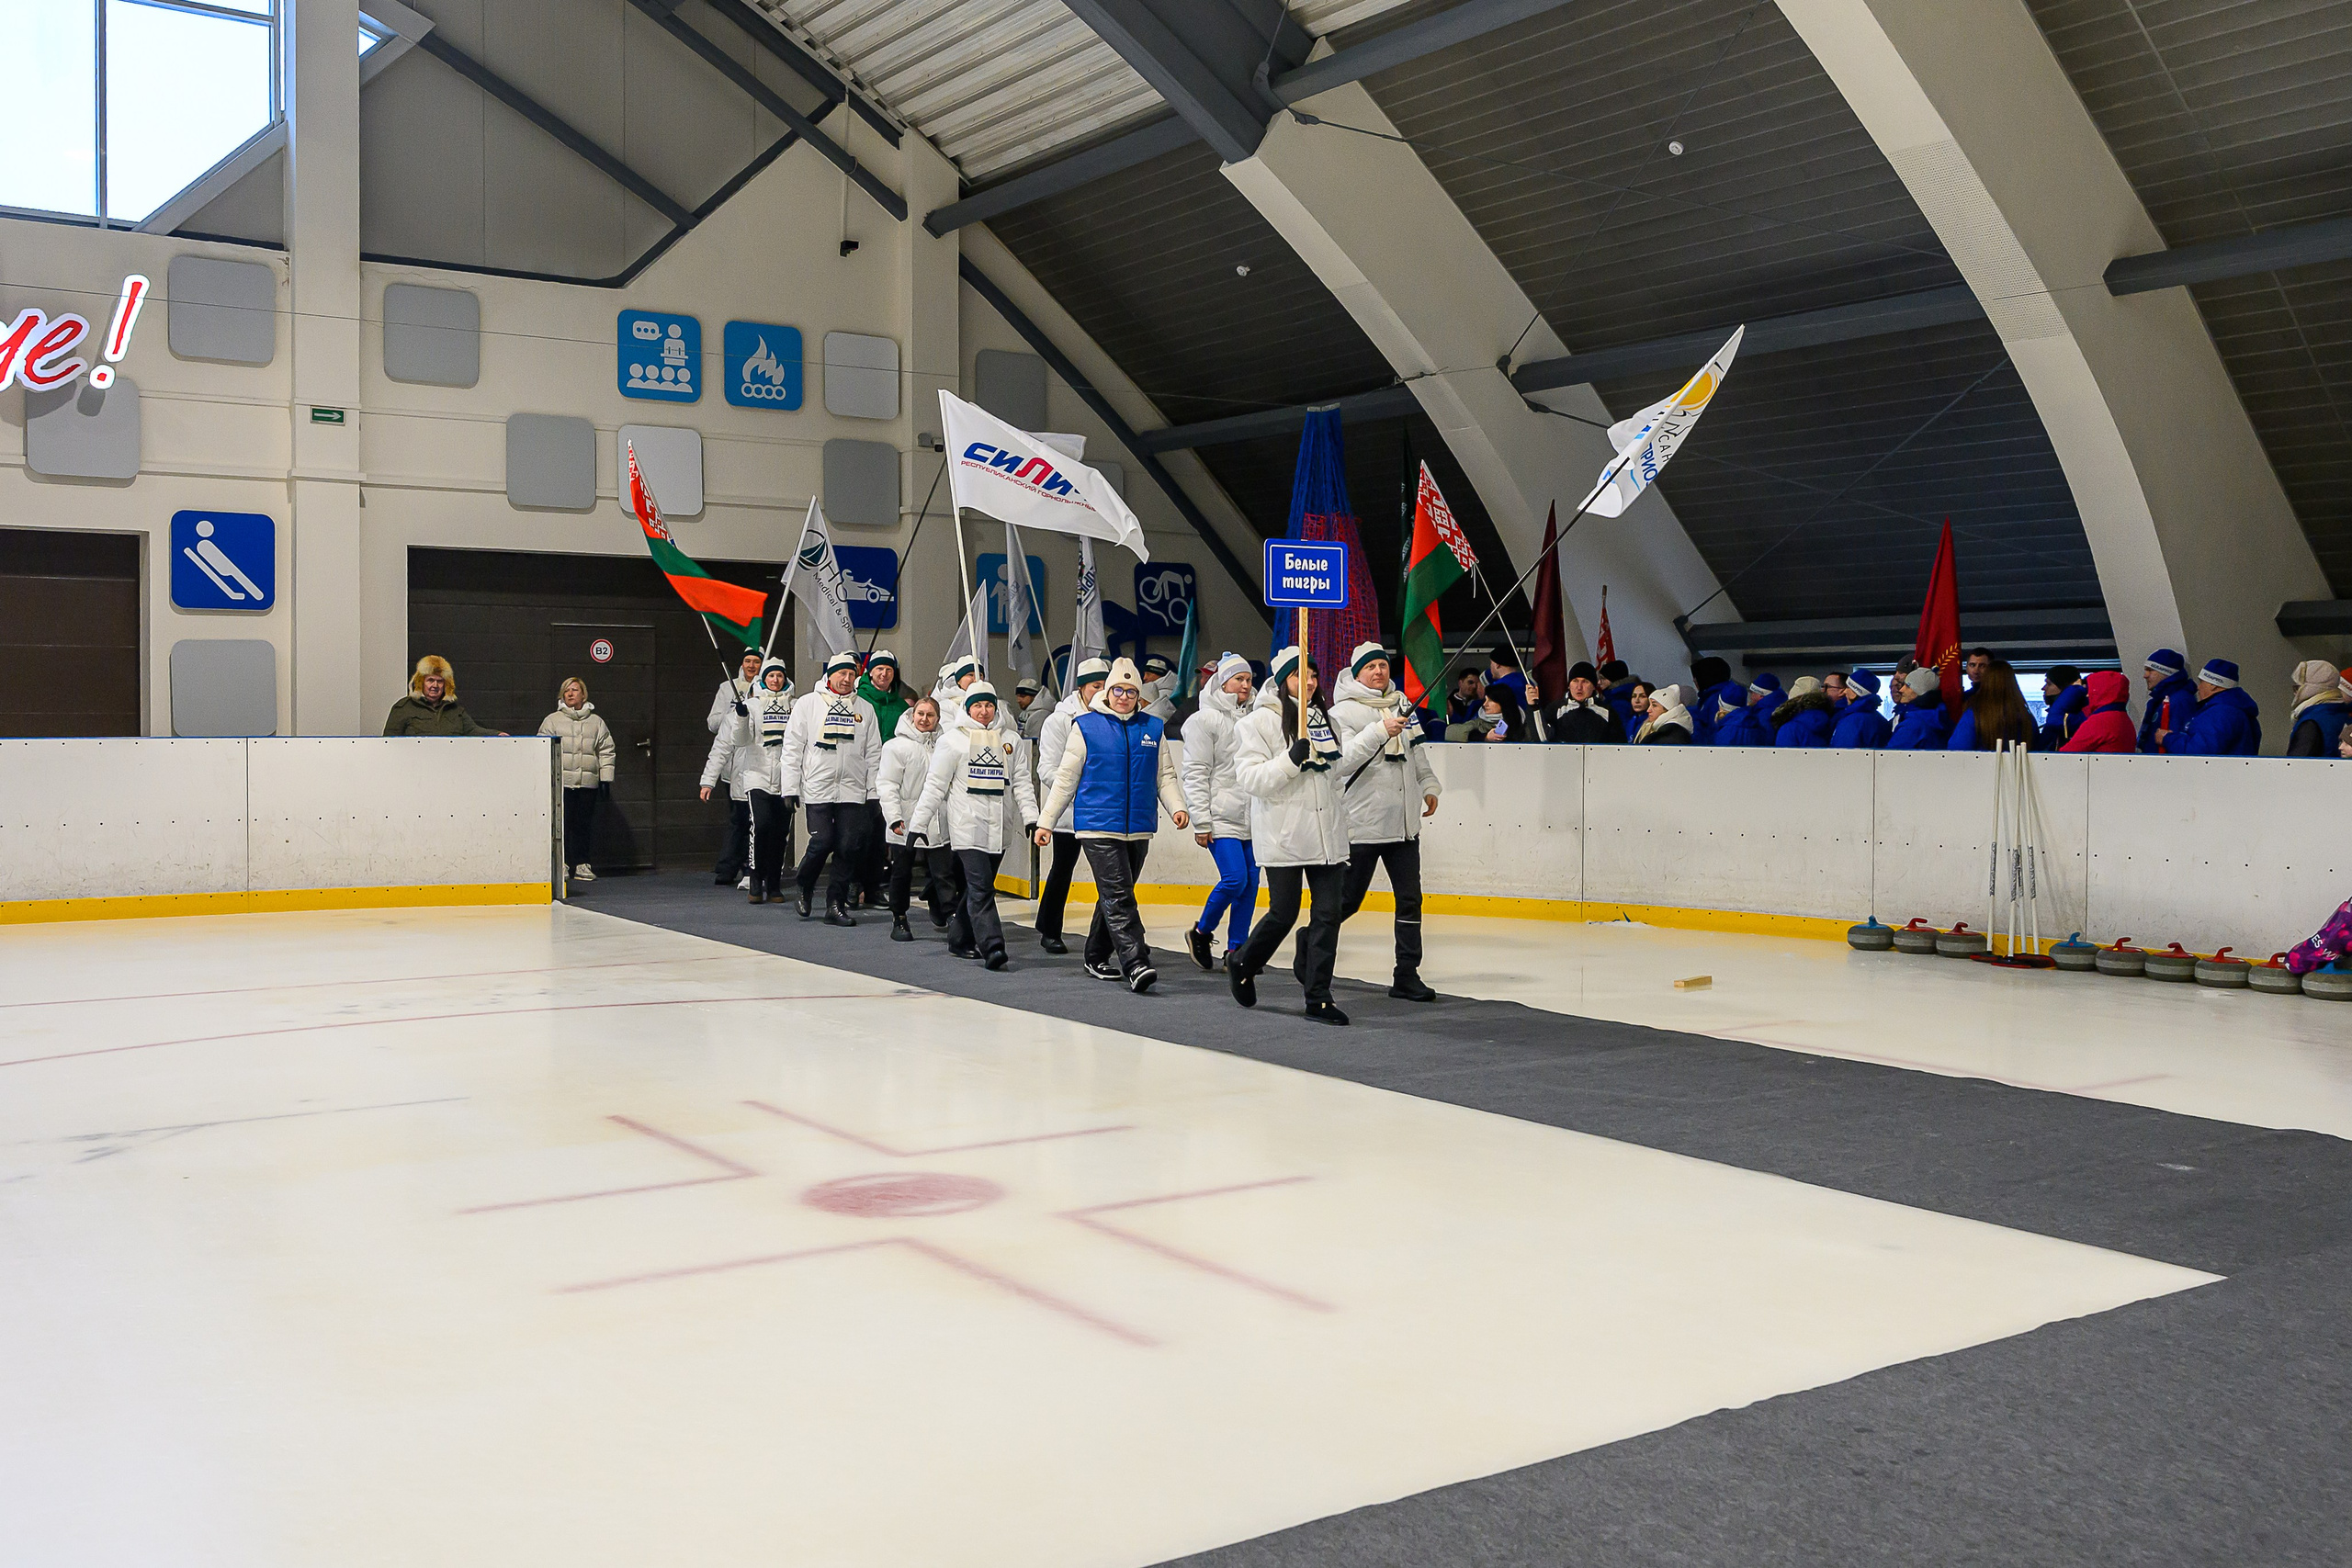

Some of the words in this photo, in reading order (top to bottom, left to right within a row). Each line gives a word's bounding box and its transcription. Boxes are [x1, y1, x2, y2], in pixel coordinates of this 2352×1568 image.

[960, 460, 1037, 493] РЕСПУБЛИКАНСКИЙ
[963, 442, 1087, 502] СИЛИ
[1640, 441, 1659, 487] ПРИО
[1284, 553, 1329, 571] Белые
[812, 571, 838, 607] Medical
[835, 607, 842, 616] &
[840, 616, 853, 634] Spa
[1282, 576, 1330, 594] тигры
